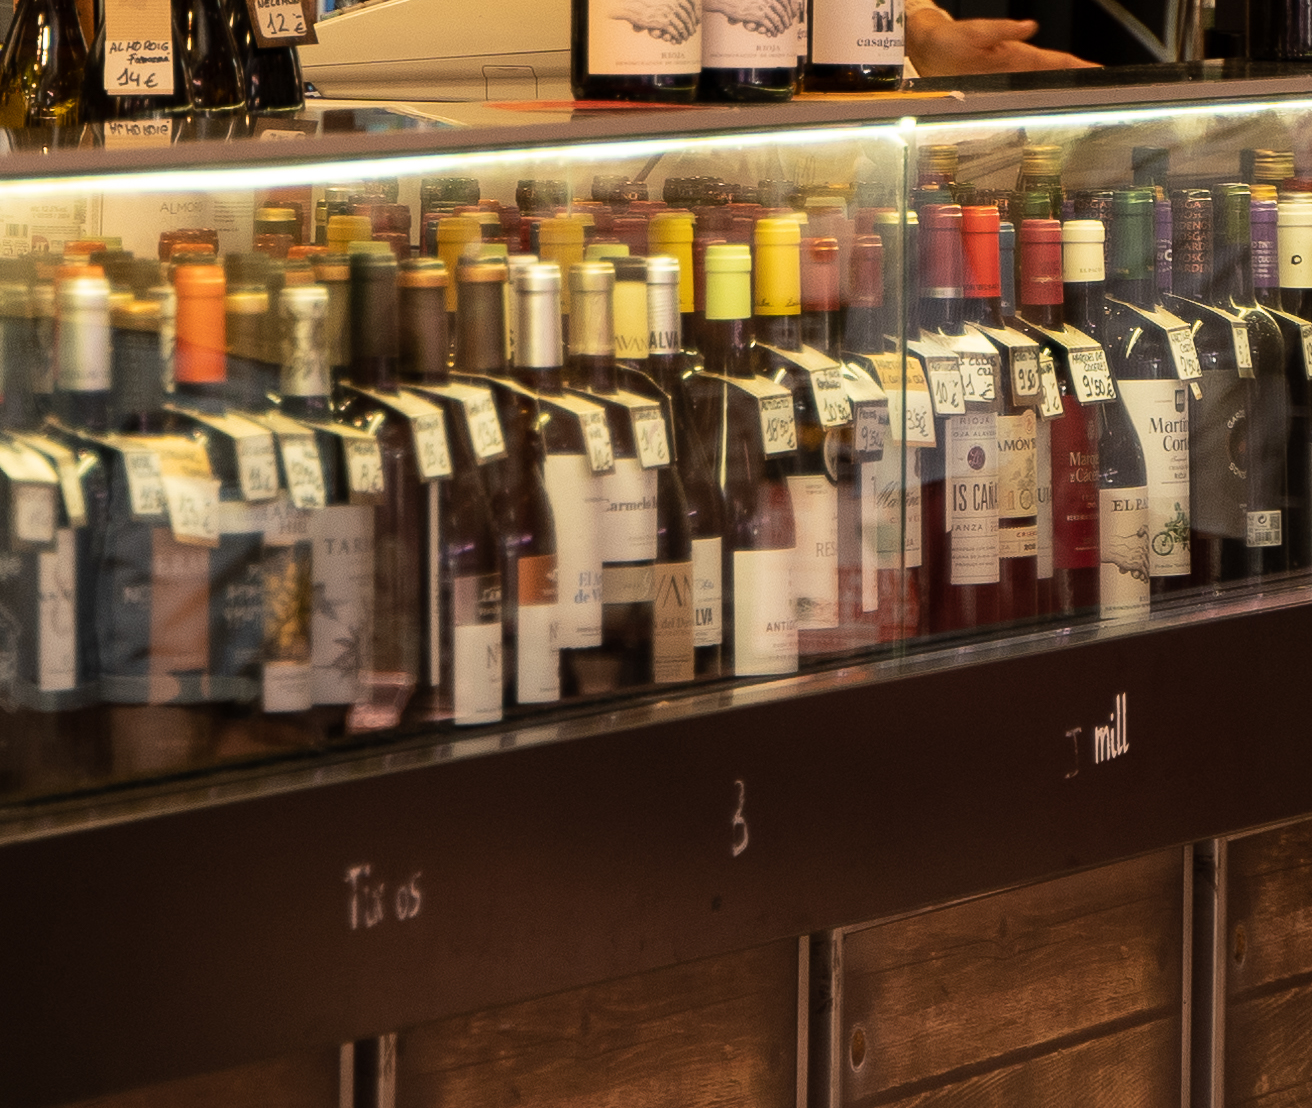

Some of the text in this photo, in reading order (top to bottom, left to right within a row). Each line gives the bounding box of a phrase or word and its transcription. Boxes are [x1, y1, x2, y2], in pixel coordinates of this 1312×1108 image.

[267, 13, 290, 35] 12
[117, 68, 159, 87] 14 €
[1082, 375, 1105, 397] 9'50
[1113, 499, 1133, 512] EL
[1095, 692, 1130, 765] mill
